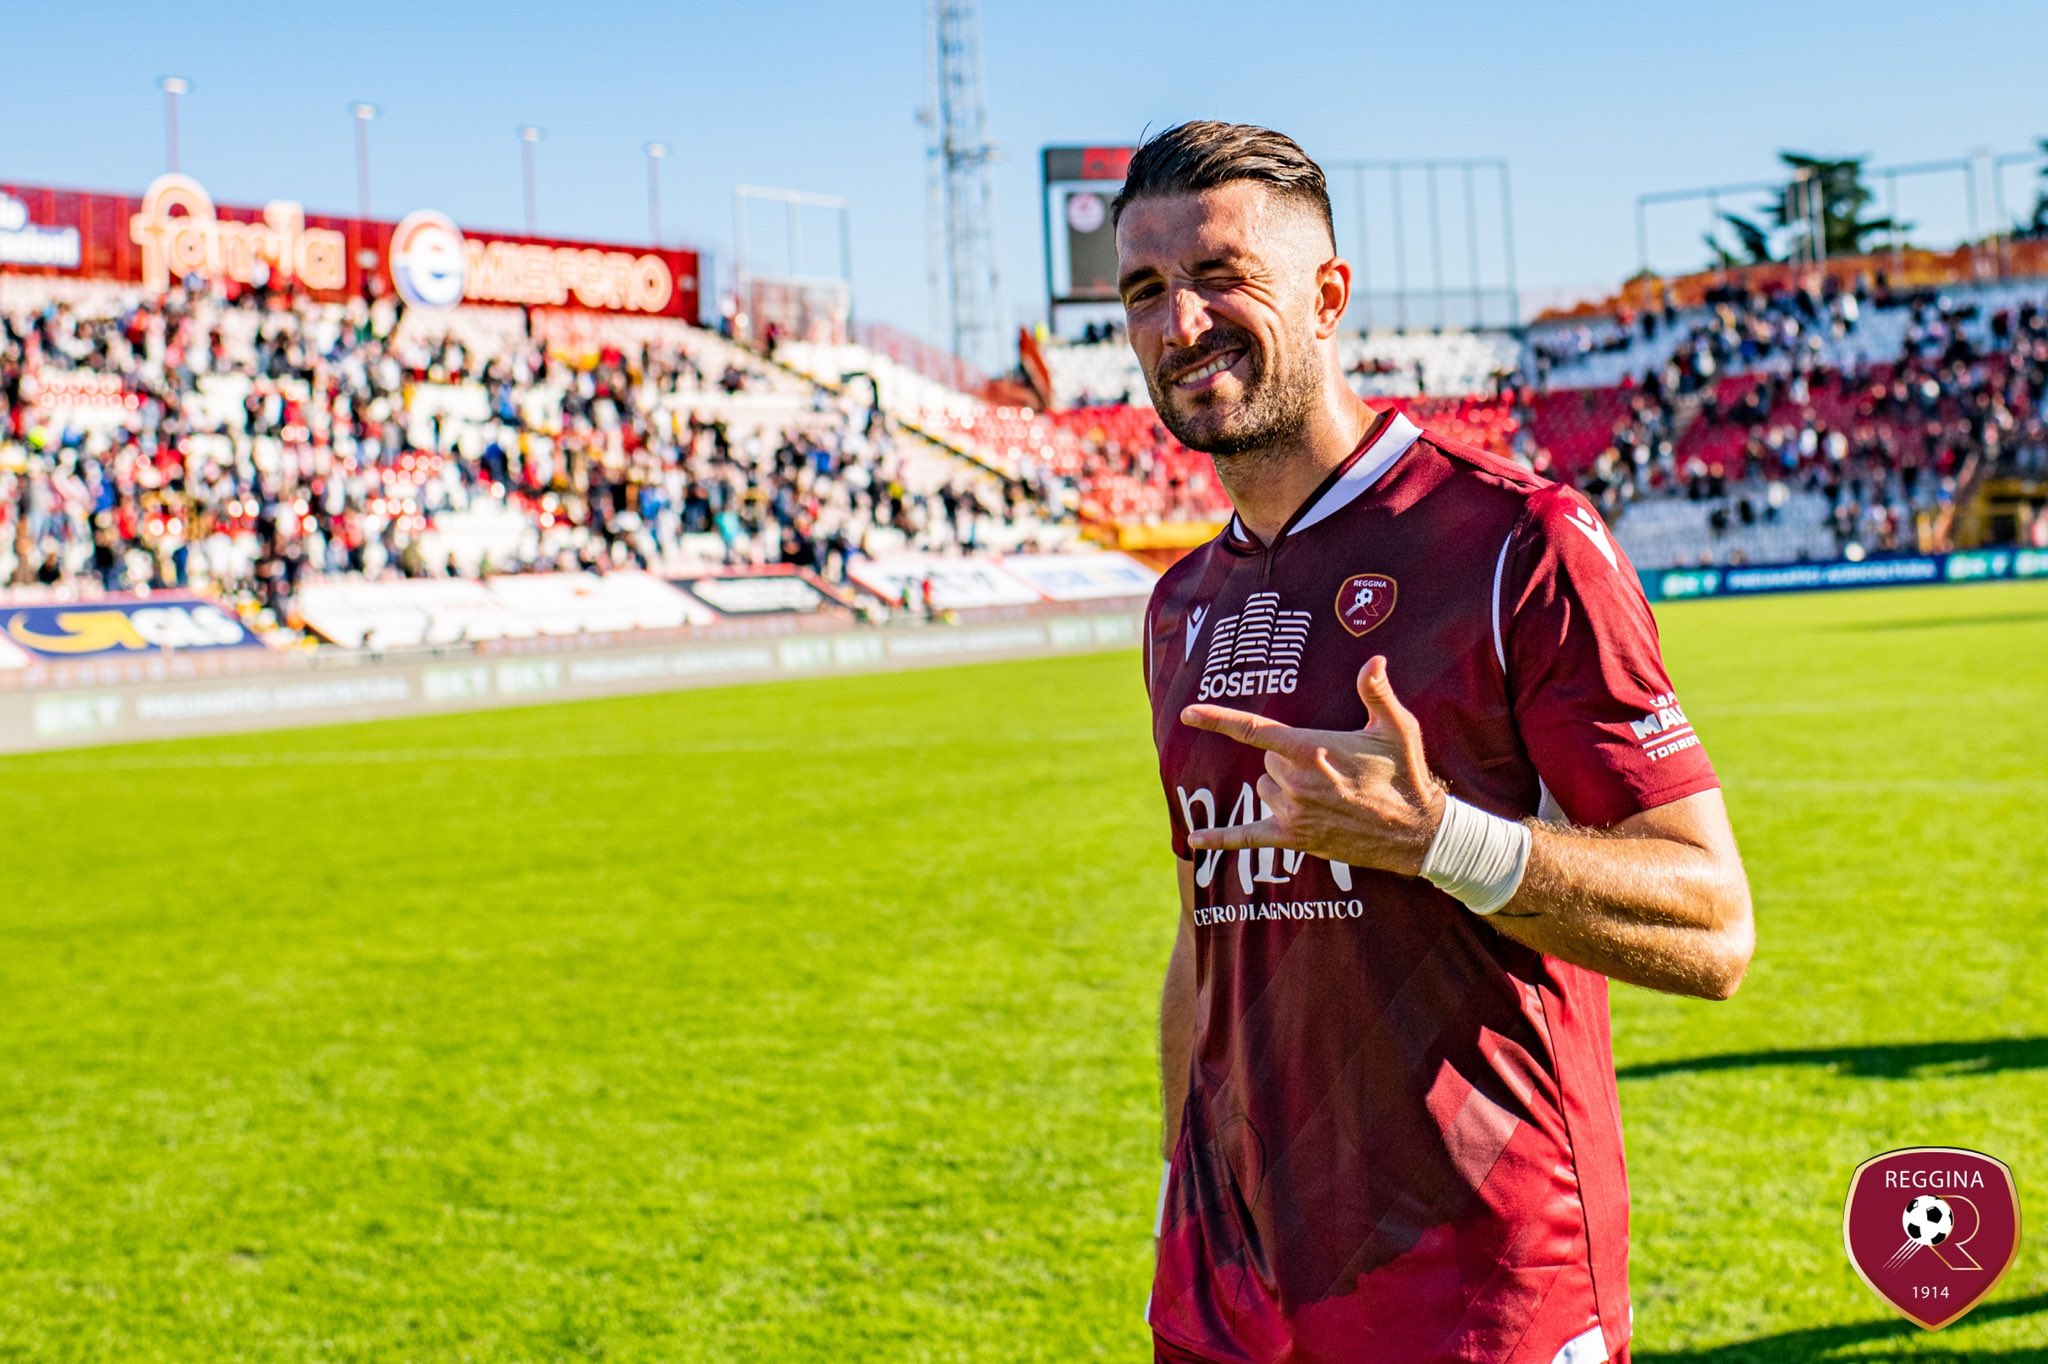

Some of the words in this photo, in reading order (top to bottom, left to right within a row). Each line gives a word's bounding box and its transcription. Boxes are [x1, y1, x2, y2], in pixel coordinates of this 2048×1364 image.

[1353, 579, 1388, 588] REGGINA
[1197, 668, 1298, 701] SOSETEG
[1239, 899, 1364, 921] DIAGNOSTICO
